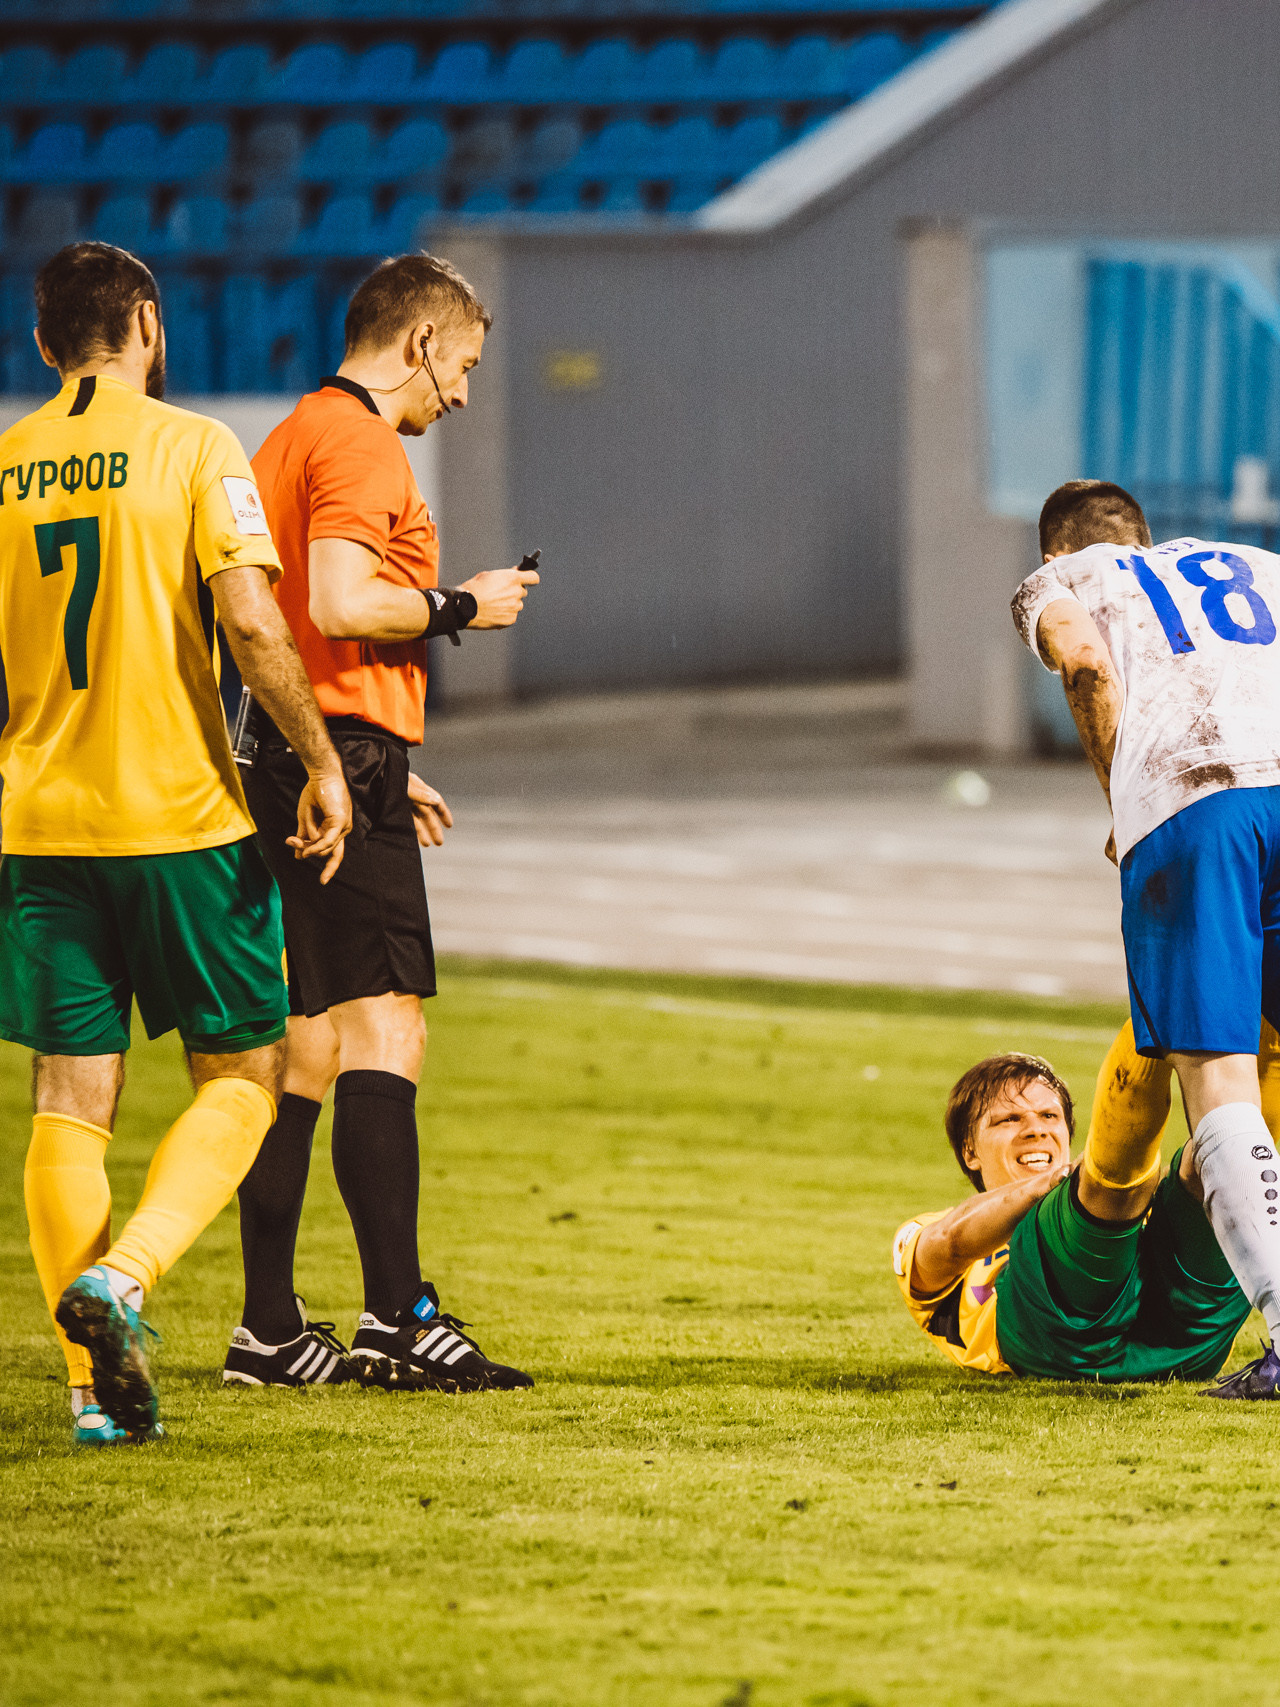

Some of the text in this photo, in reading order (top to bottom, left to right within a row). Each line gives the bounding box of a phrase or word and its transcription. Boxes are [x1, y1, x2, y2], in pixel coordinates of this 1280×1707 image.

[0, 452, 129, 506] ГУРФОВ
[34, 516, 101, 690] 7
[1115, 550, 1277, 655] 18
